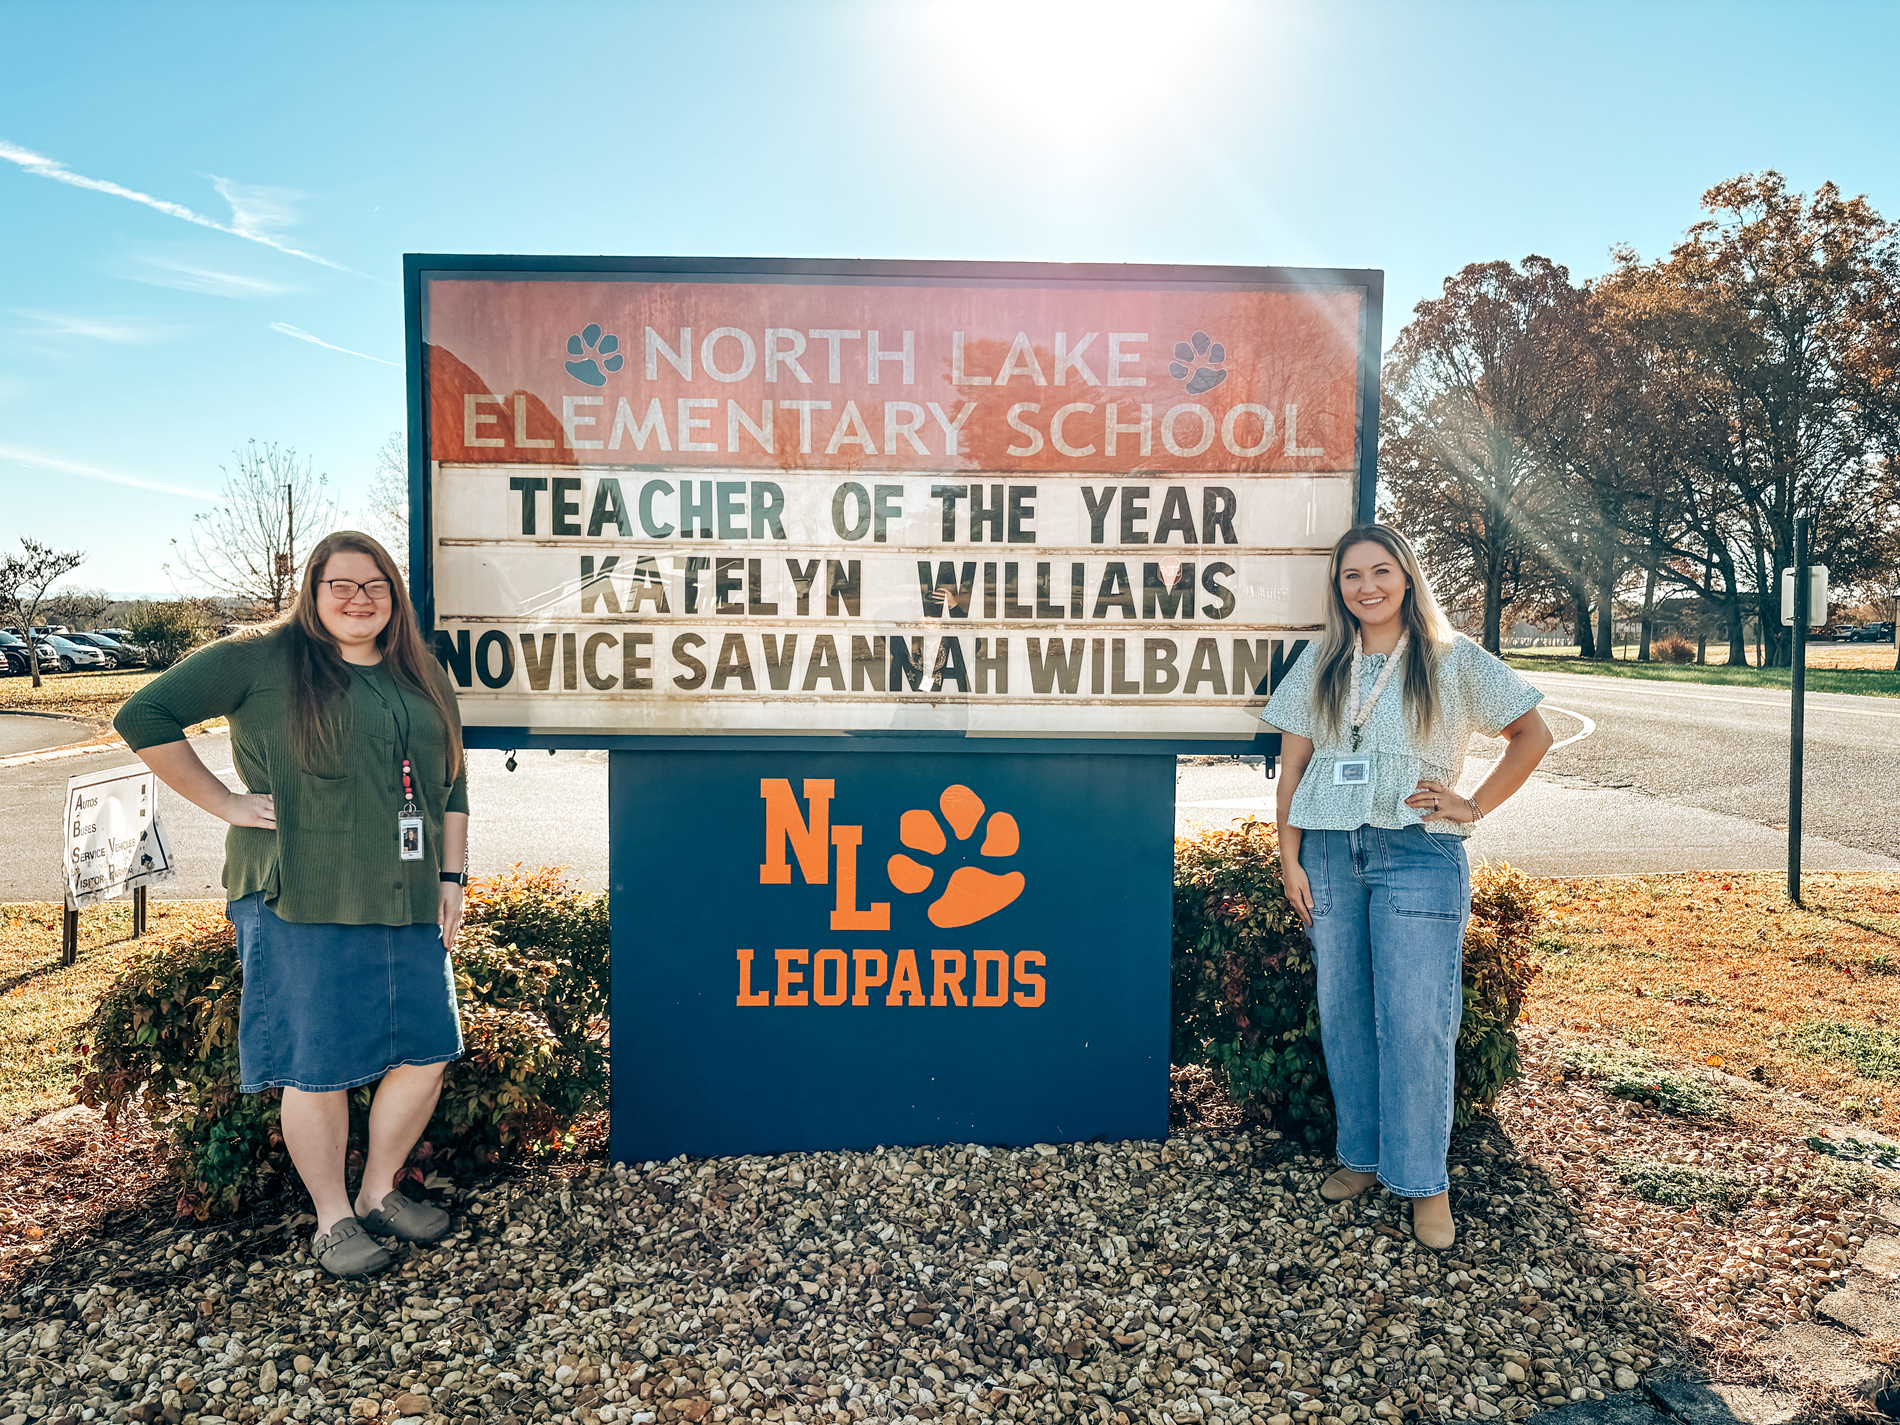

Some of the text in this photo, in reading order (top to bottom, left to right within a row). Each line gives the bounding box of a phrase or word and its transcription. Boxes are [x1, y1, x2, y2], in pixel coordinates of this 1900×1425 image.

[644, 325, 1149, 386] NORTH LAKE
[463, 393, 1324, 458] ELEMENTARY SCHOOL
[509, 476, 1238, 545] TEACHER OF THE YEAR
[580, 556, 1236, 620] KATELYN WILLIAMS
[434, 629, 653, 691] NOVICE
[672, 632, 1009, 694] SAVANNAH
[72, 847, 106, 864] SERVICE
[736, 948, 1046, 1007] LEOPARDS
